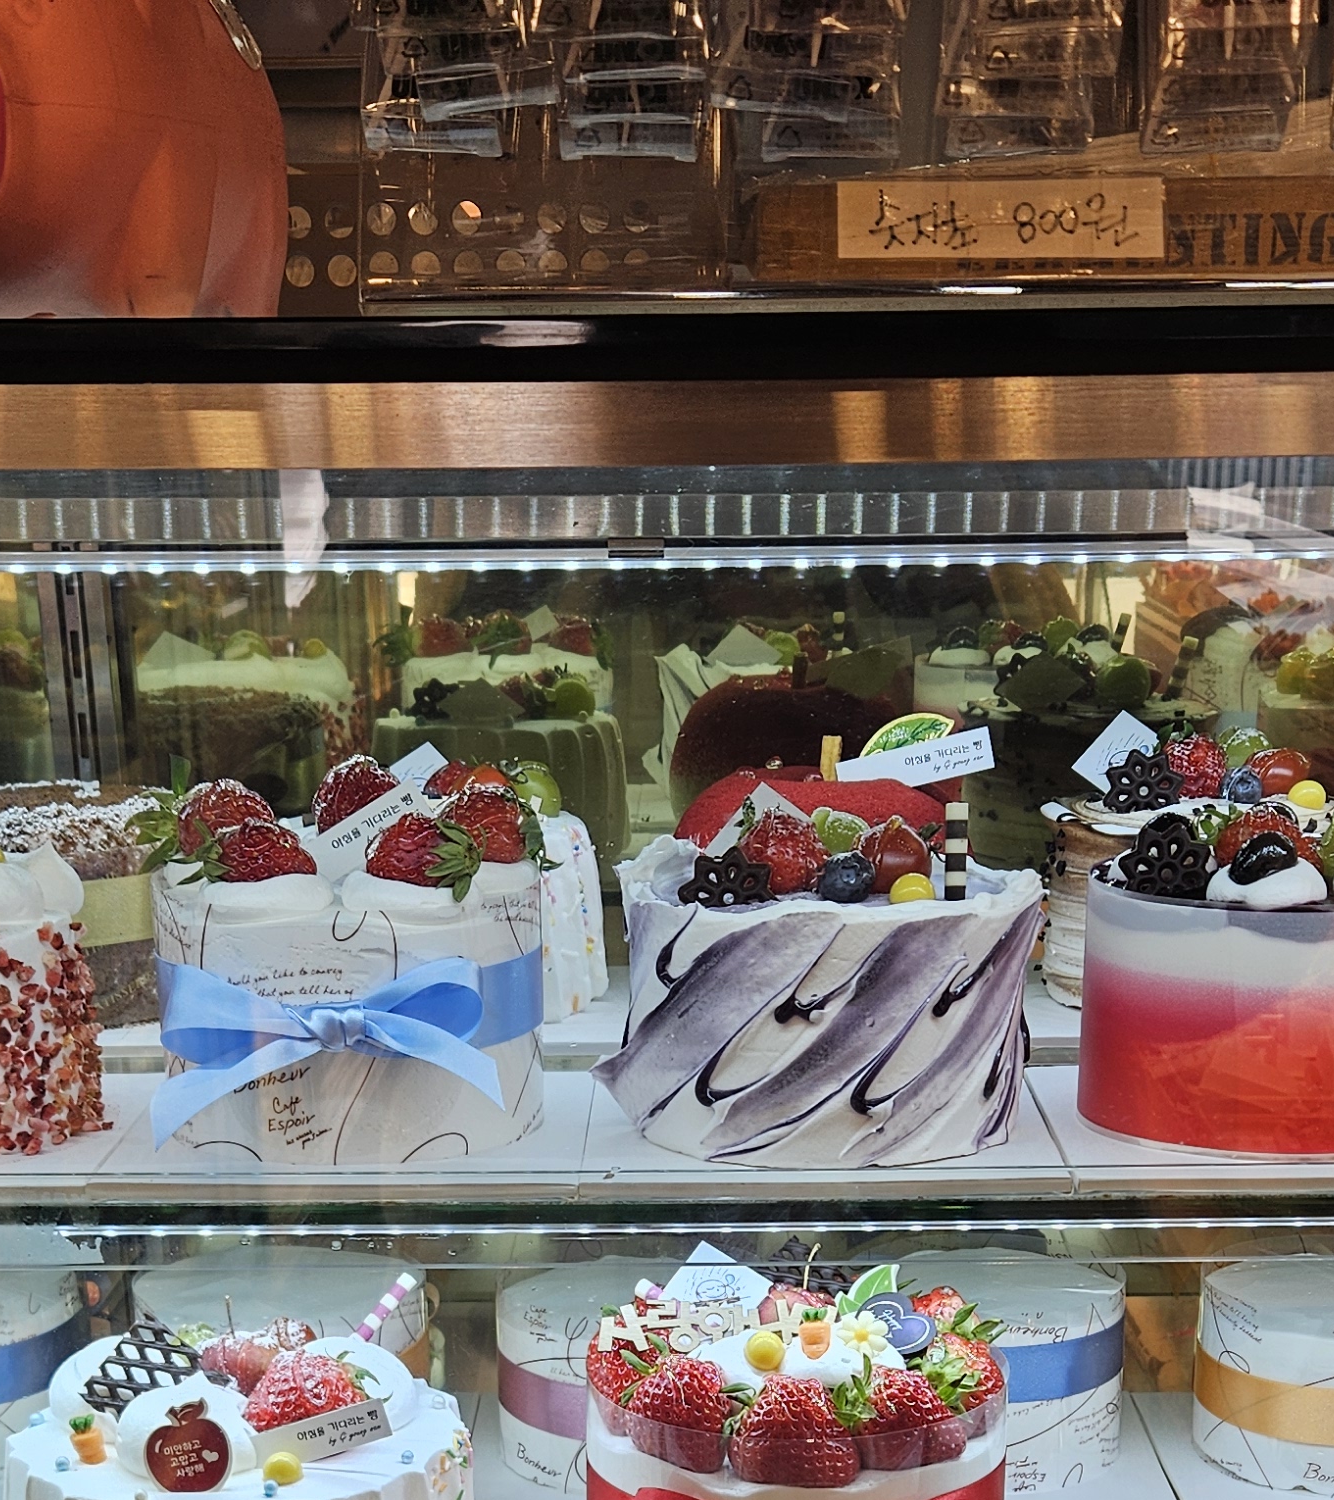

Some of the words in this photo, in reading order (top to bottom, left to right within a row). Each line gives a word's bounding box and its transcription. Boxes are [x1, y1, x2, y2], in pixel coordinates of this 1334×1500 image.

[1013, 192, 1140, 248] 800원
[904, 753, 931, 767] 아침을
[933, 744, 970, 759] 기다리는
[972, 739, 983, 752] 빵
[360, 804, 402, 829] 기다리는
[272, 1096, 302, 1117] Cafe
[267, 1110, 306, 1136] Espoir
[296, 1426, 326, 1443] 아침을
[327, 1415, 366, 1432] 기다리는
[367, 1409, 379, 1422] 빵
[163, 1439, 203, 1456] 미안하고
[517, 1442, 562, 1478] Bonheur
[176, 1462, 205, 1478] 사랑해
